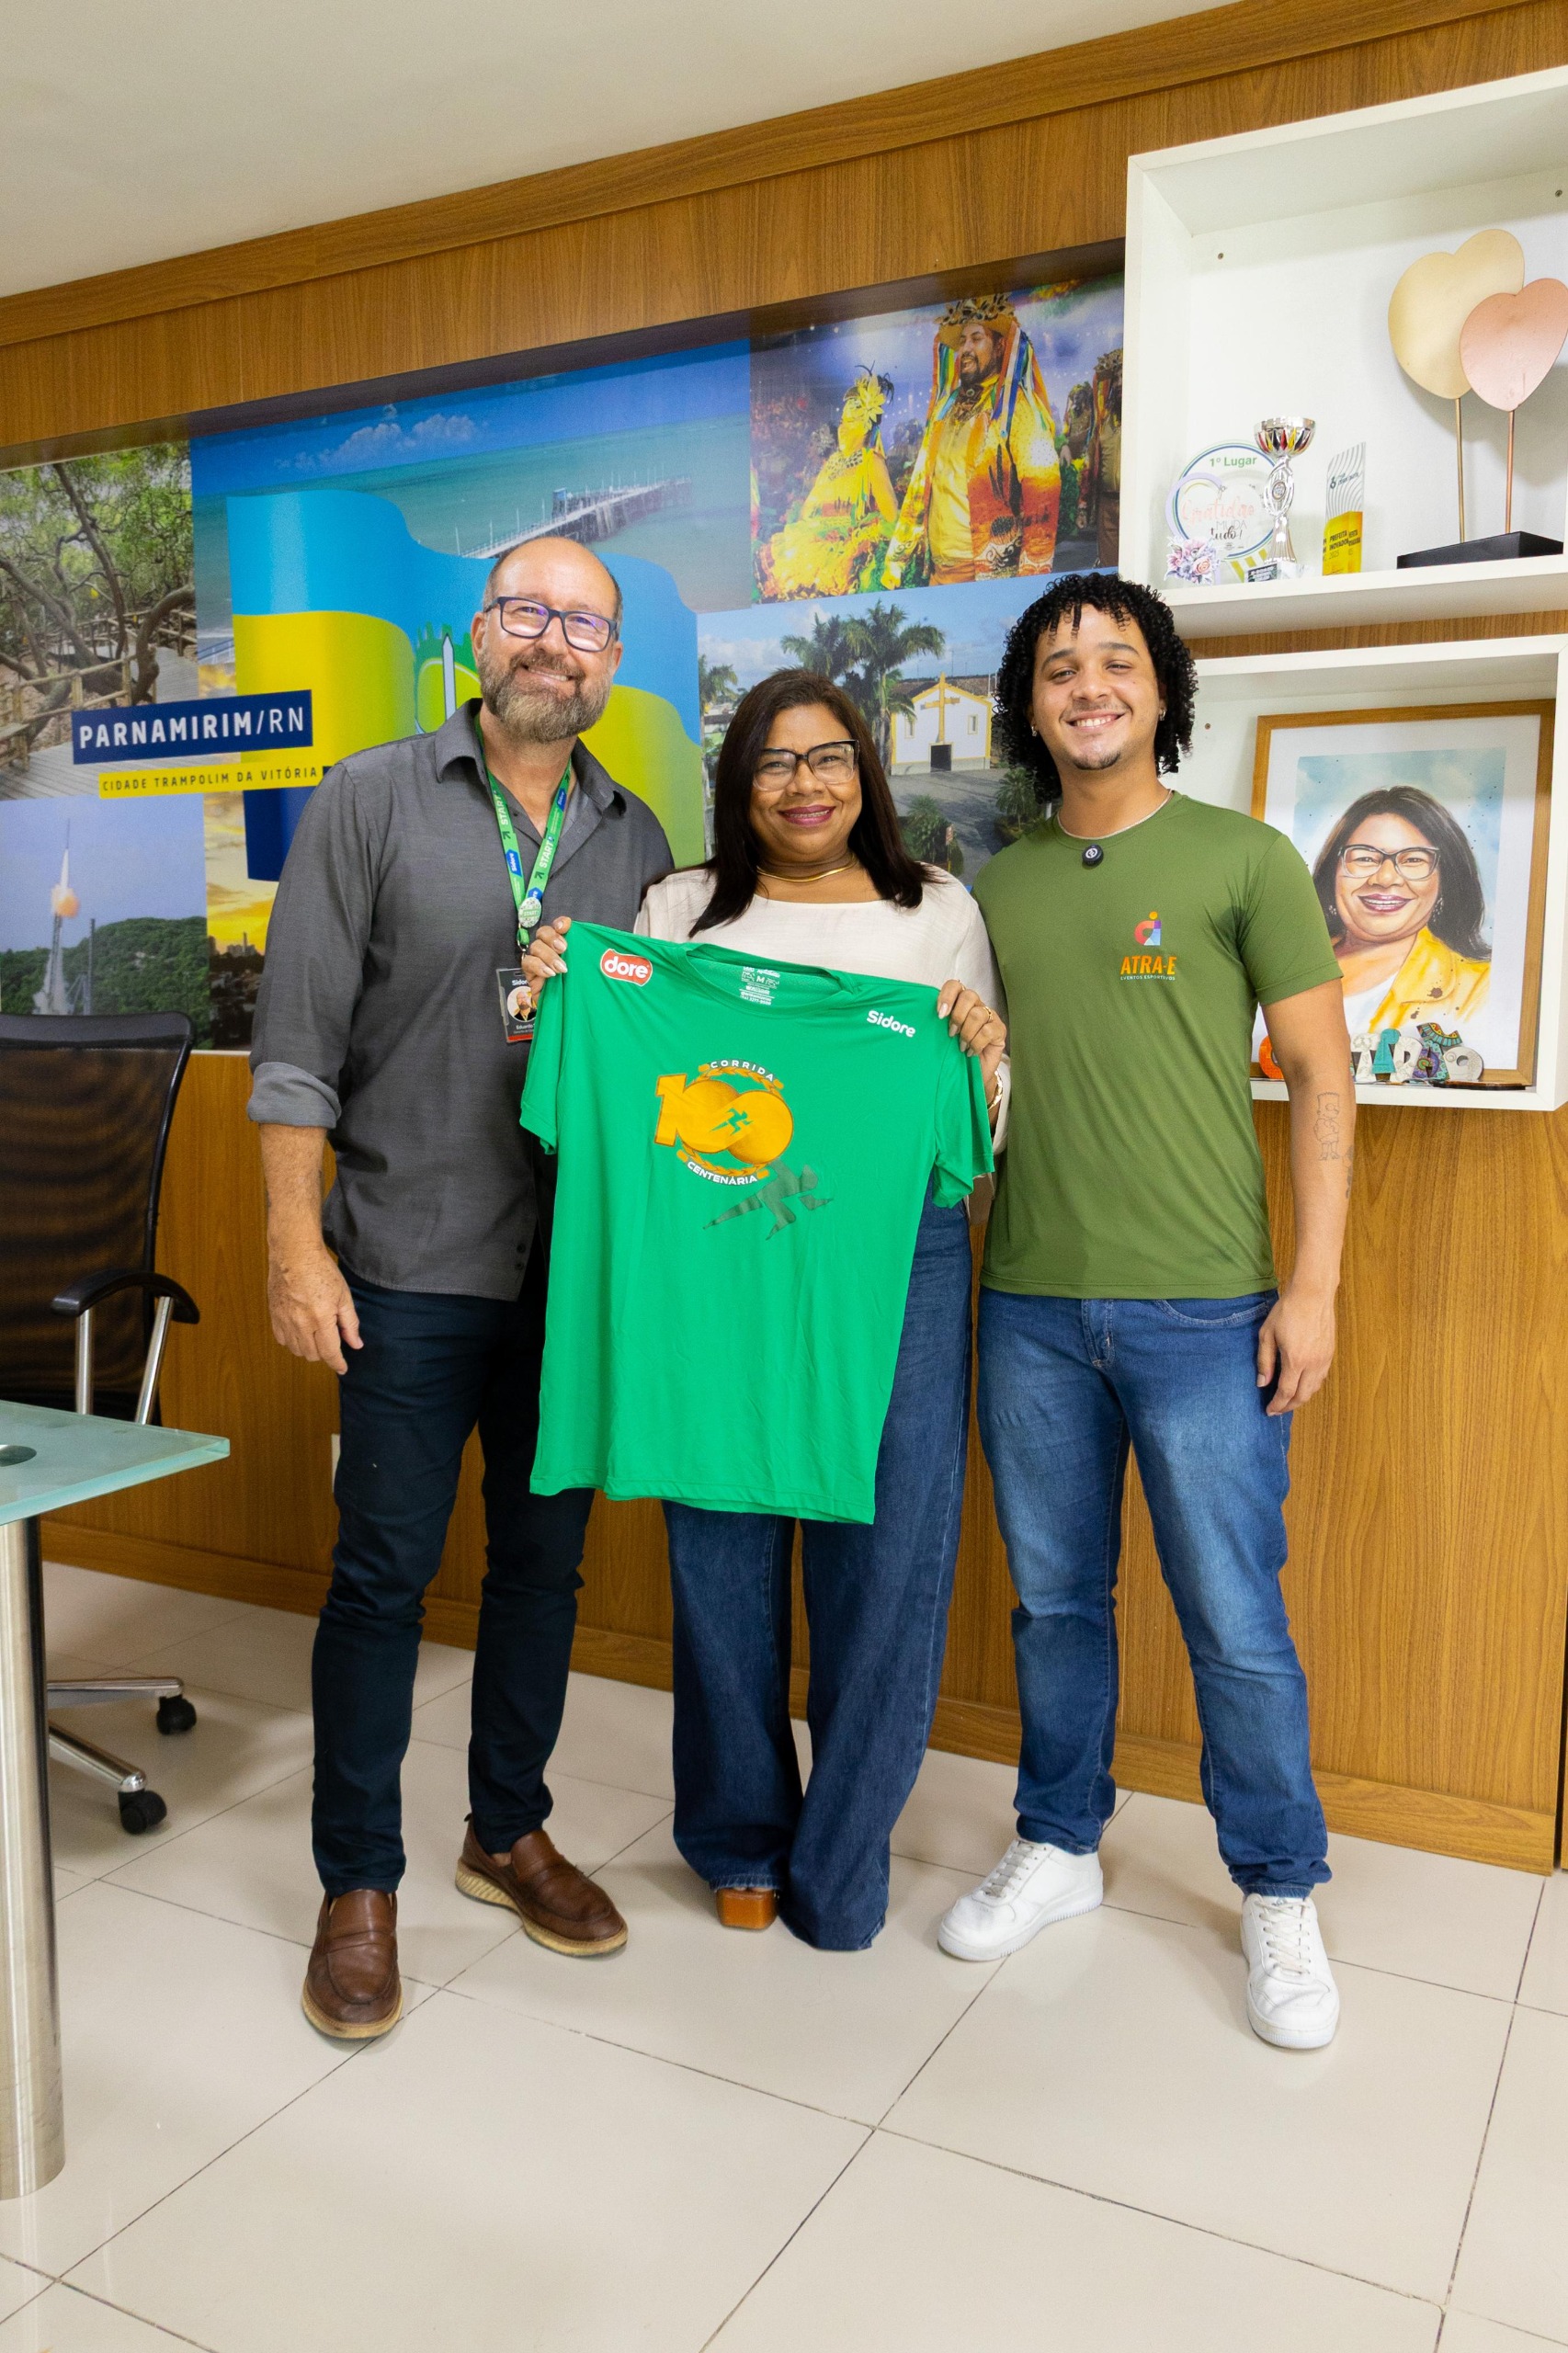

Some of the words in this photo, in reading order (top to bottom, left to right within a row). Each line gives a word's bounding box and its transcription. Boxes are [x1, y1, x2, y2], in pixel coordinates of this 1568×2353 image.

[1224, 456, 1257, 468] Lugar
[1215, 519, 1248, 530] MUDA
[79, 707, 304, 749] PARNAMIRIM/RN
[103, 778, 147, 791] CIDADE
[154, 772, 229, 788] TRAMPOLIM
[237, 771, 253, 782] DA
[261, 766, 317, 780] VITÓRIA
[539, 839, 554, 869] START
[604, 956, 649, 979] dore
[1120, 955, 1177, 975] ATRA-E
[866, 1010, 916, 1038] Sidore
[710, 1060, 774, 1082] CORRIDA
[687, 1161, 758, 1186] CENTENÁRIA
